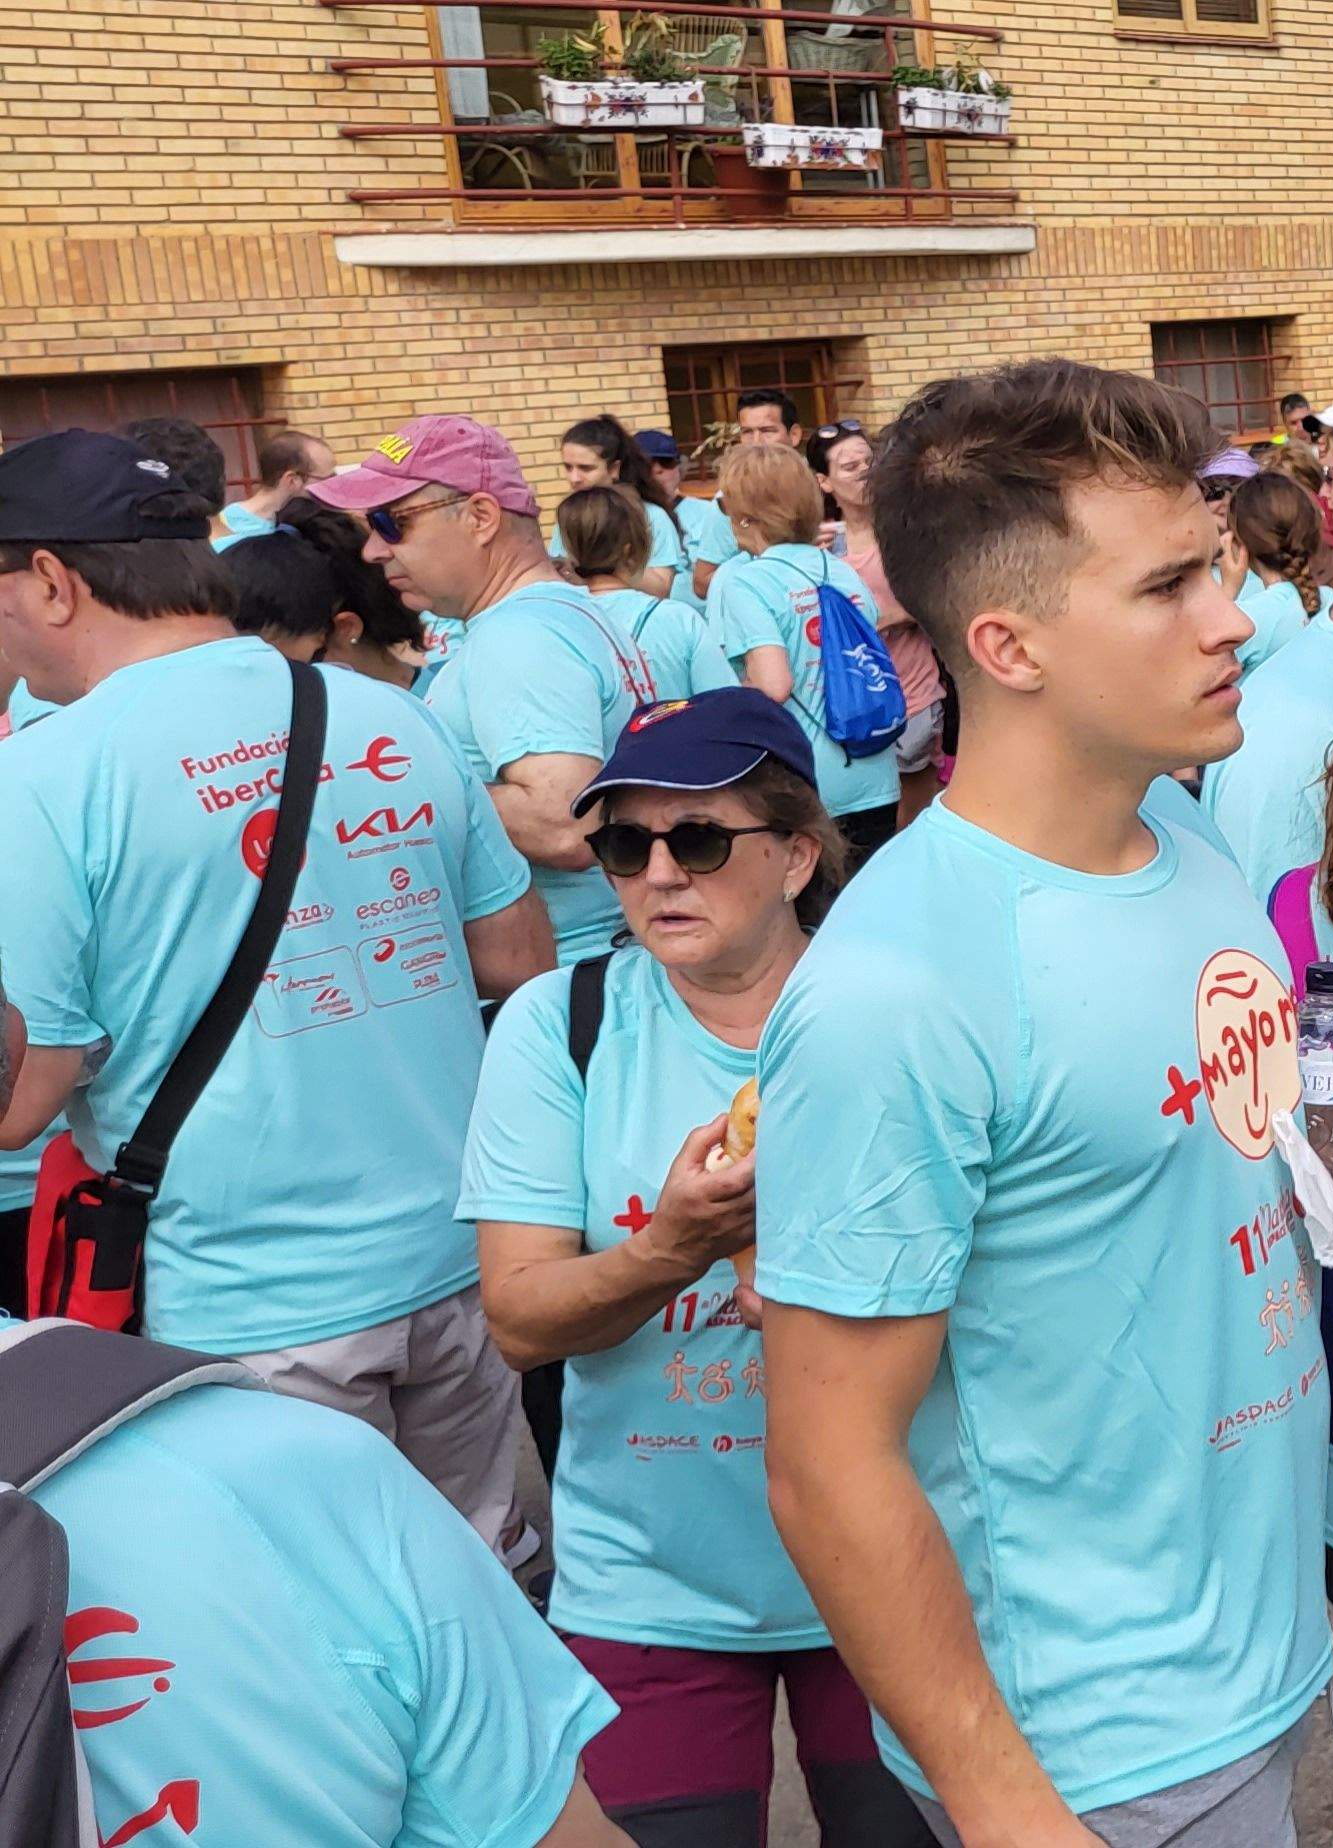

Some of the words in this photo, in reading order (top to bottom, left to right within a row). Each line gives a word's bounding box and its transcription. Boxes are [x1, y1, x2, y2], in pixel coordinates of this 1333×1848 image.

[180, 730, 292, 780] Fundació
[196, 762, 335, 815] iberCa
[356, 887, 441, 920] escaneo
